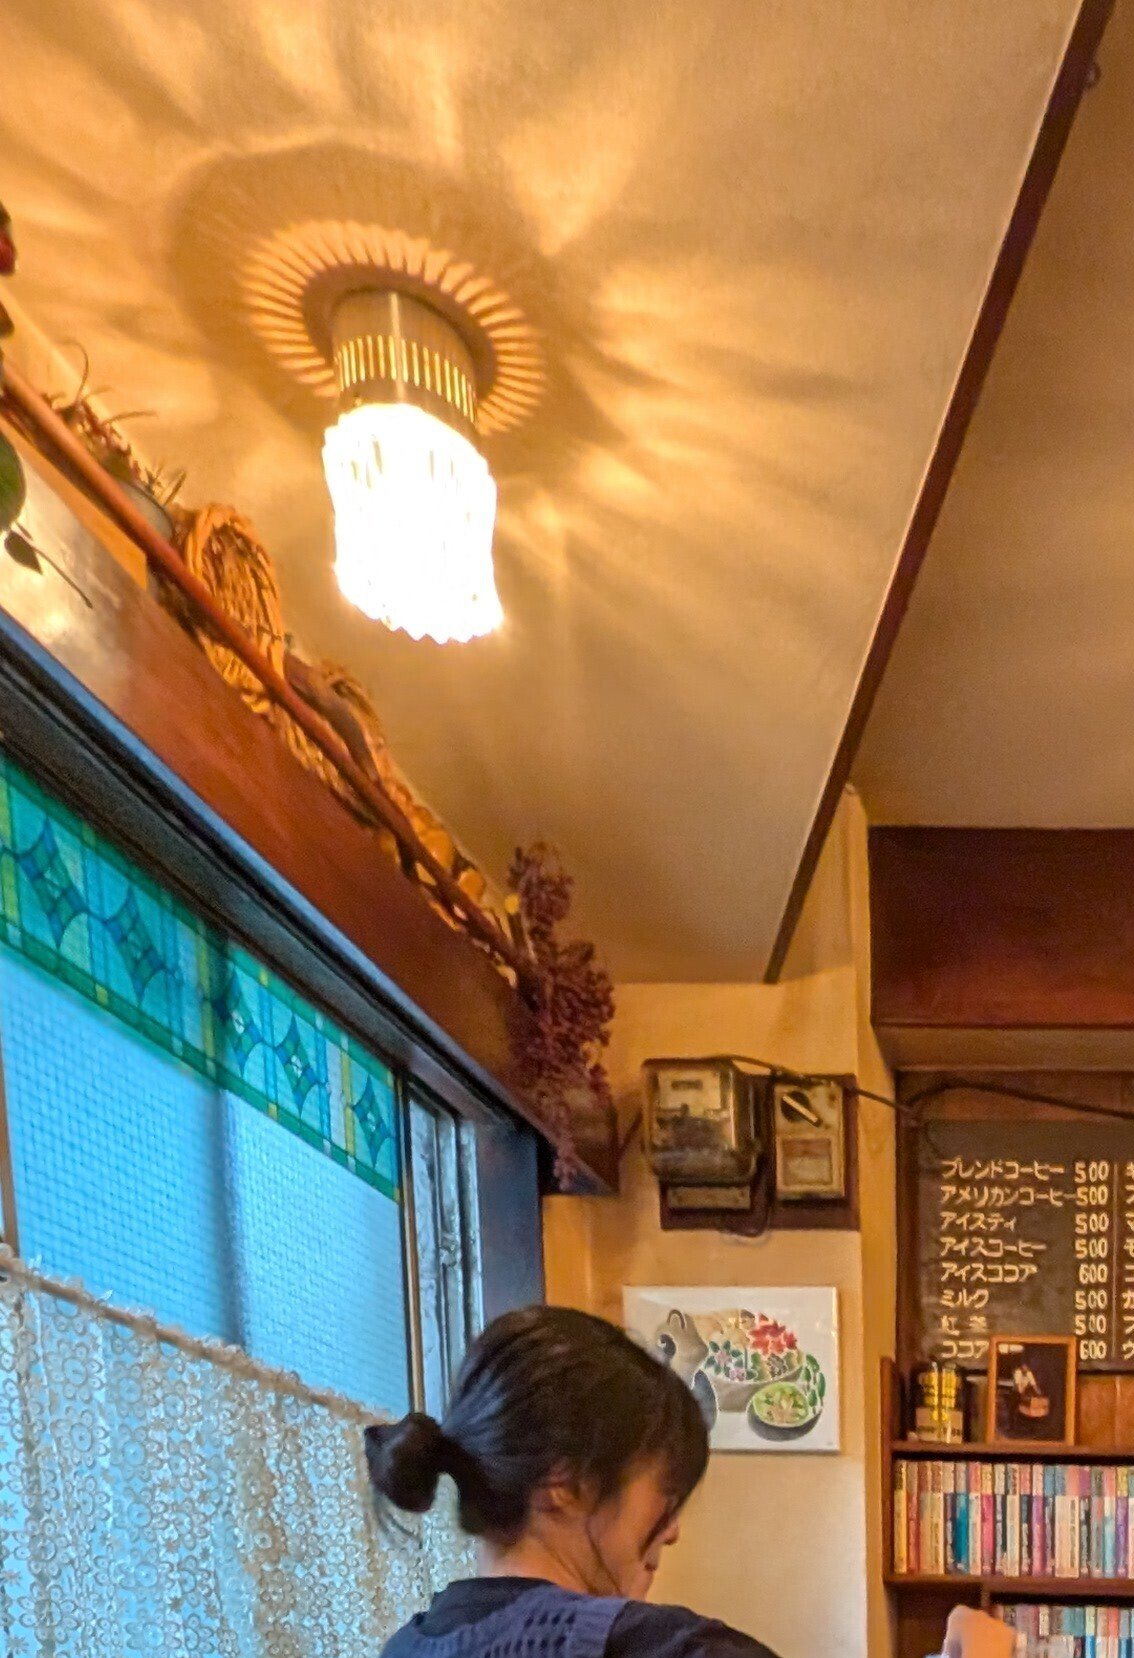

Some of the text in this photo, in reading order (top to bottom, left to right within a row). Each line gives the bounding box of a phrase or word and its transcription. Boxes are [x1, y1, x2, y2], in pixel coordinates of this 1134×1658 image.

[941, 1155, 1109, 1183] ブレンドコーヒー 500
[940, 1185, 1108, 1208] アメリカンコーヒー 500
[940, 1211, 1109, 1235] アイスティ 500
[940, 1236, 1108, 1259] アイスコーヒー 500
[940, 1262, 1108, 1284] アイスココア 600
[940, 1288, 1108, 1311] ミルク 500
[1074, 1314, 1107, 1336] 500
[941, 1339, 1107, 1360] ココア 600
